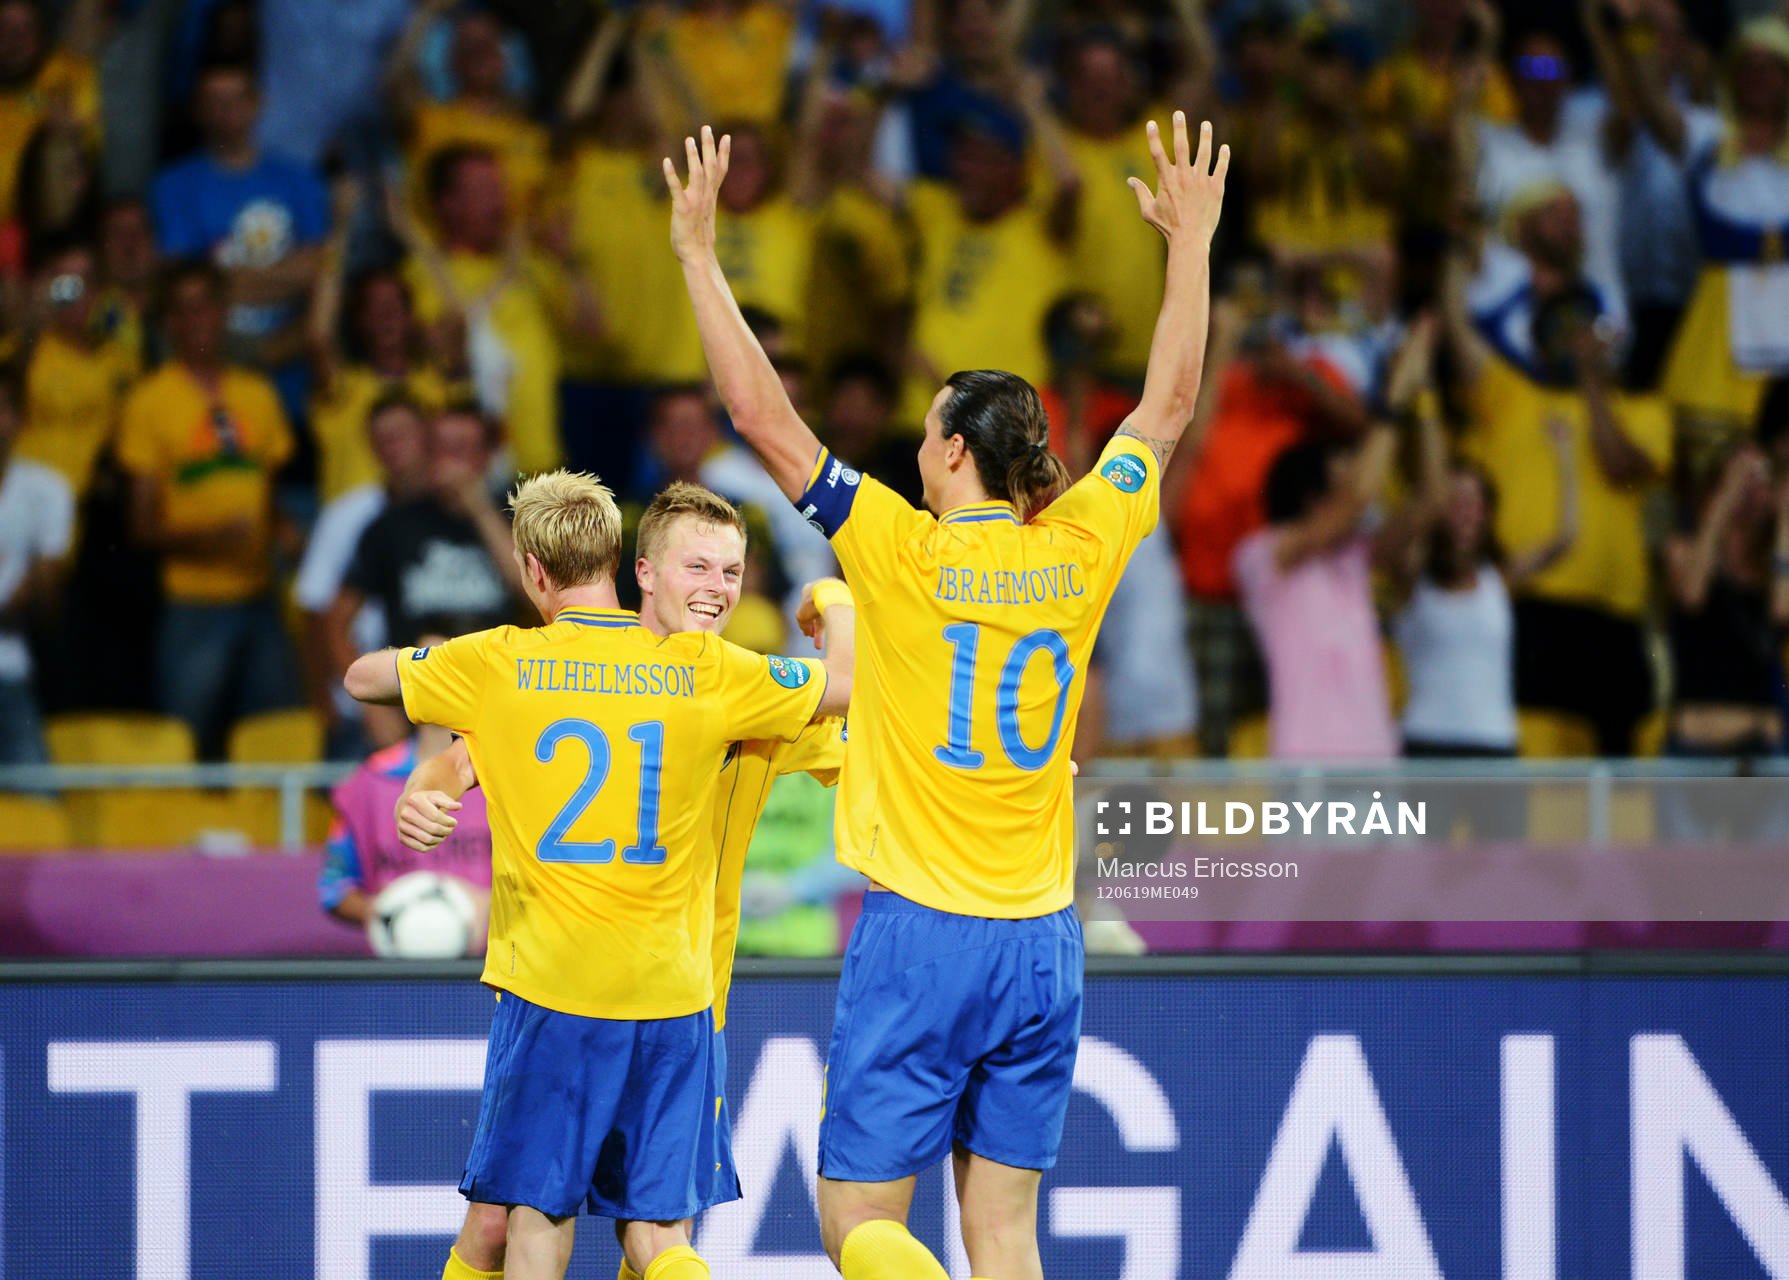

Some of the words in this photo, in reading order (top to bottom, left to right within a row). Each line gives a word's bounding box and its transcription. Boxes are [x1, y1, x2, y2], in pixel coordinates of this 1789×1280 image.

[516, 658, 695, 697] WILHELMSSON
[932, 621, 1076, 771] 10
[535, 718, 667, 864] 21
